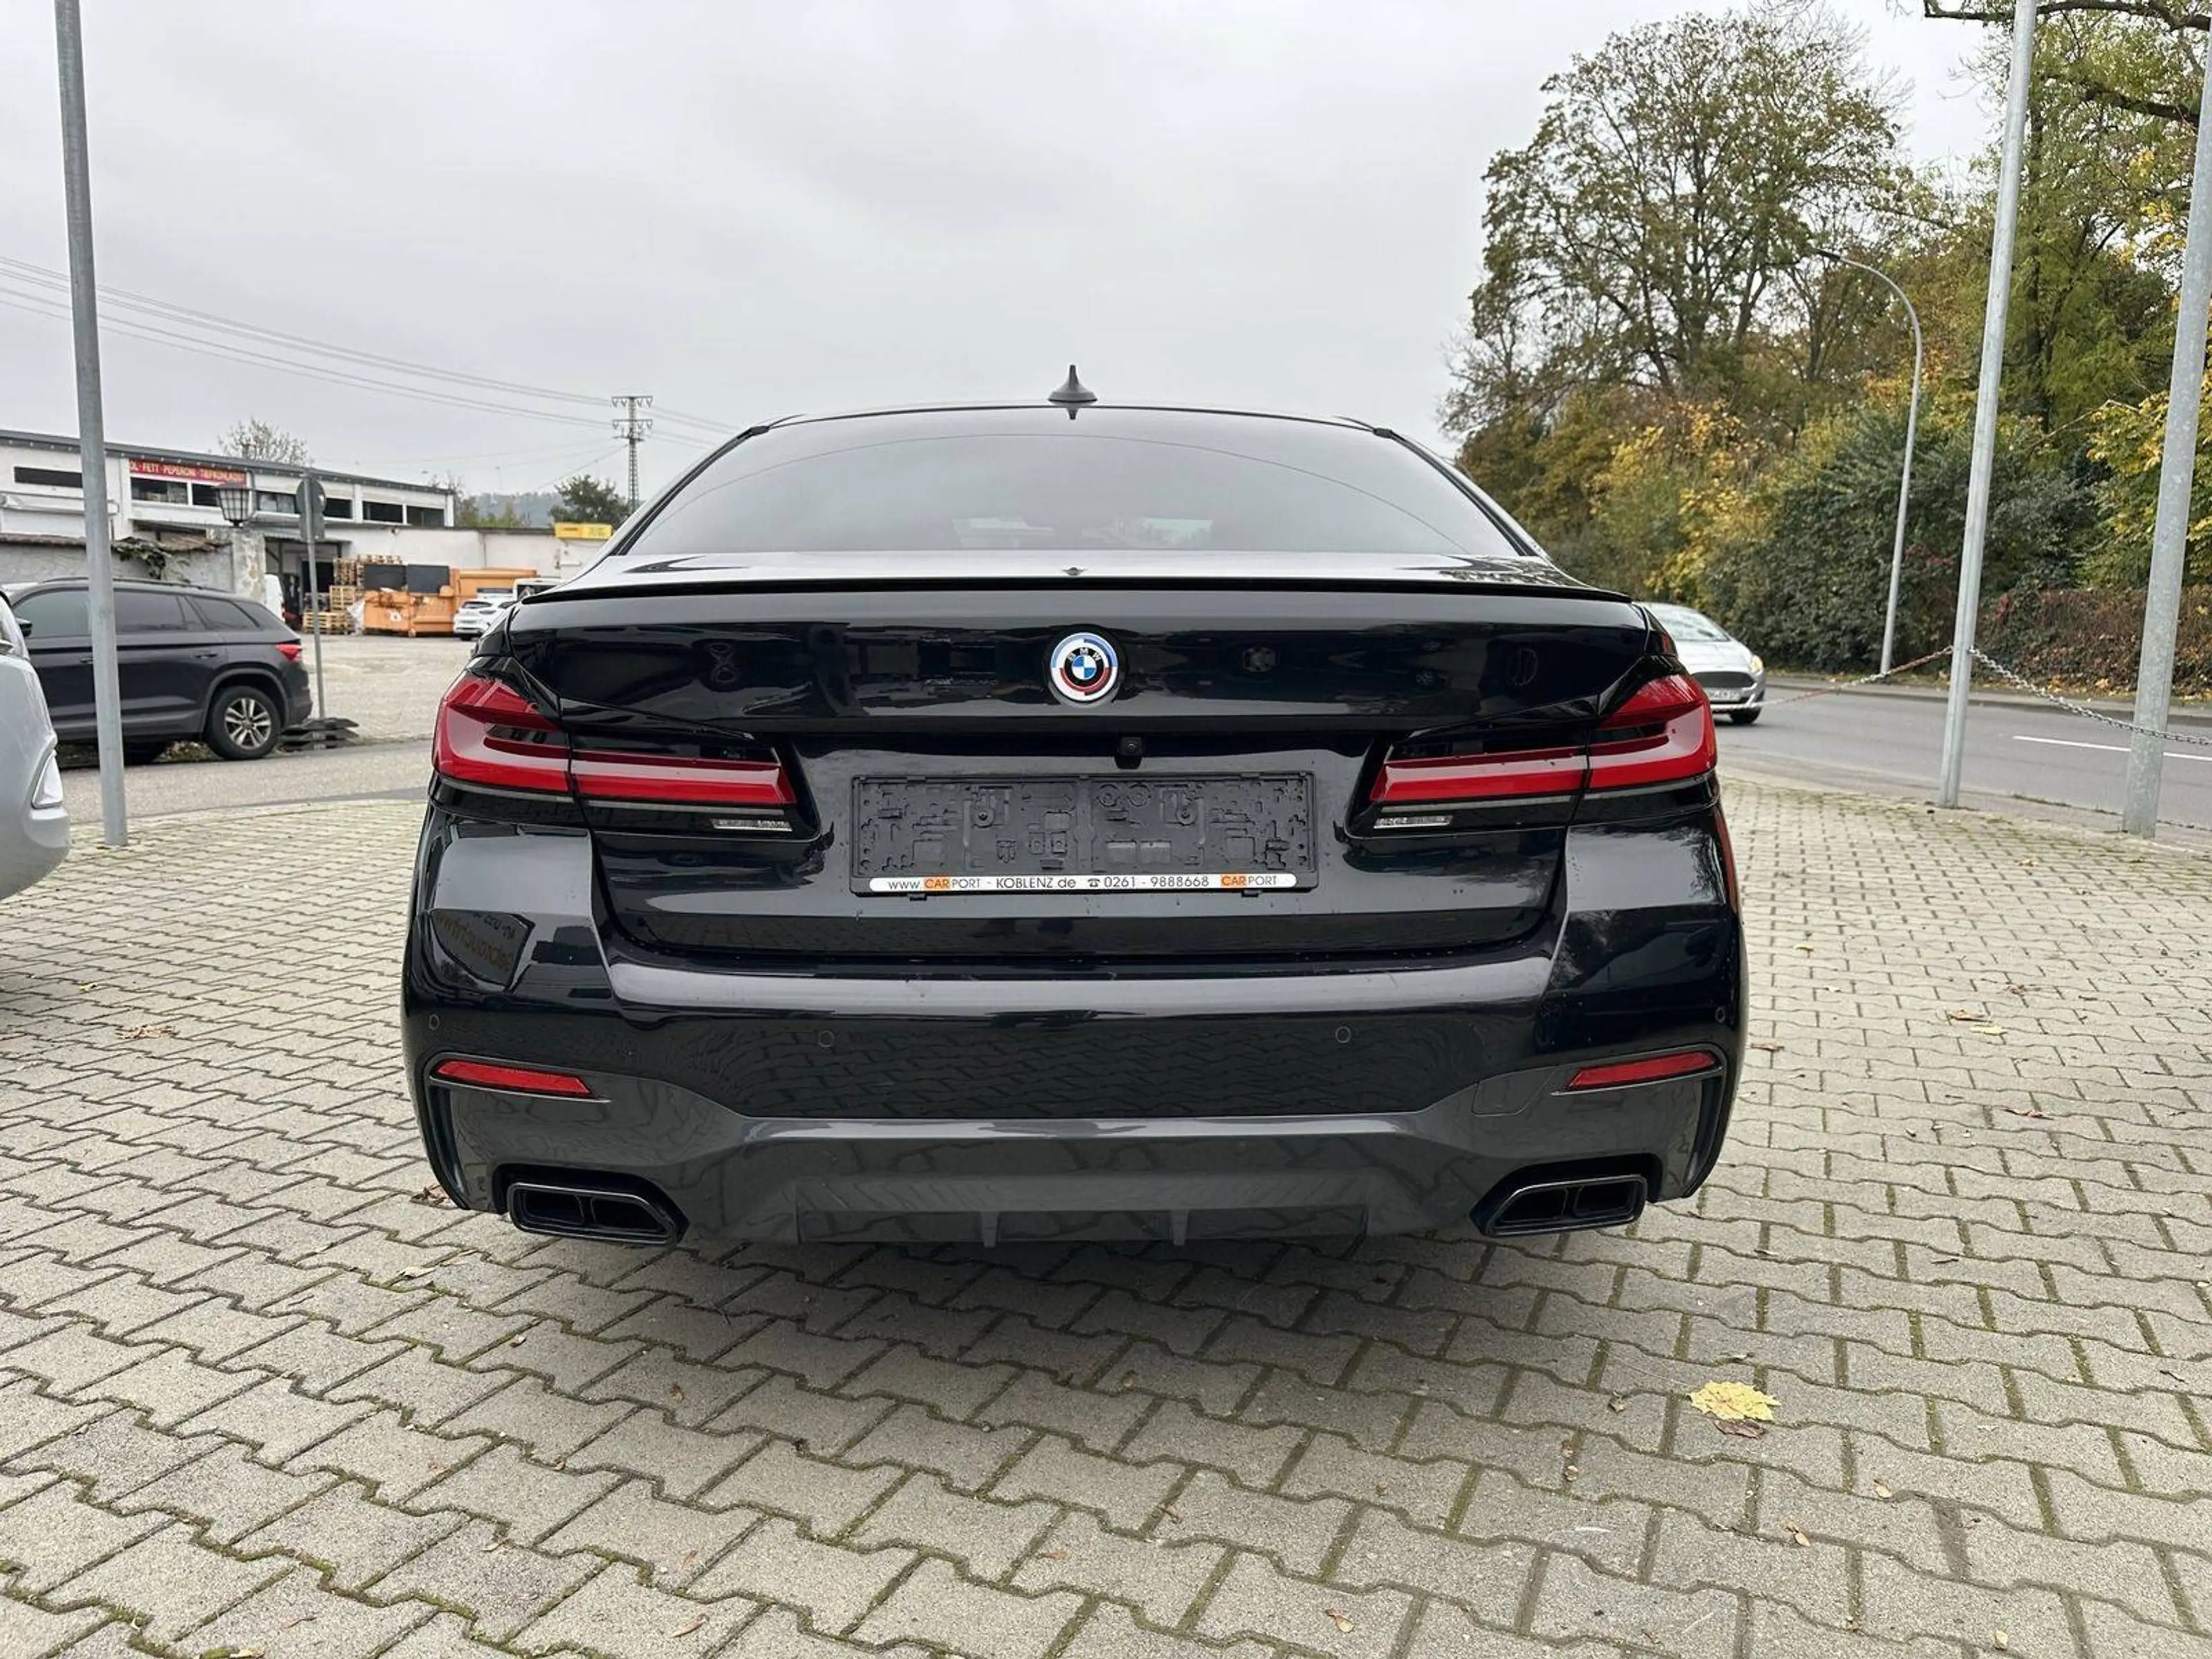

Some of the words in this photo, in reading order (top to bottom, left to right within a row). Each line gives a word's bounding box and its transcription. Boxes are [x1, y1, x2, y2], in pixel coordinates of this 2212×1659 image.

[1067, 647, 1101, 662] BMW
[1104, 876, 1135, 887] 0261
[1150, 876, 1209, 887] 9888668
[1221, 875, 1277, 885] CARPORT
